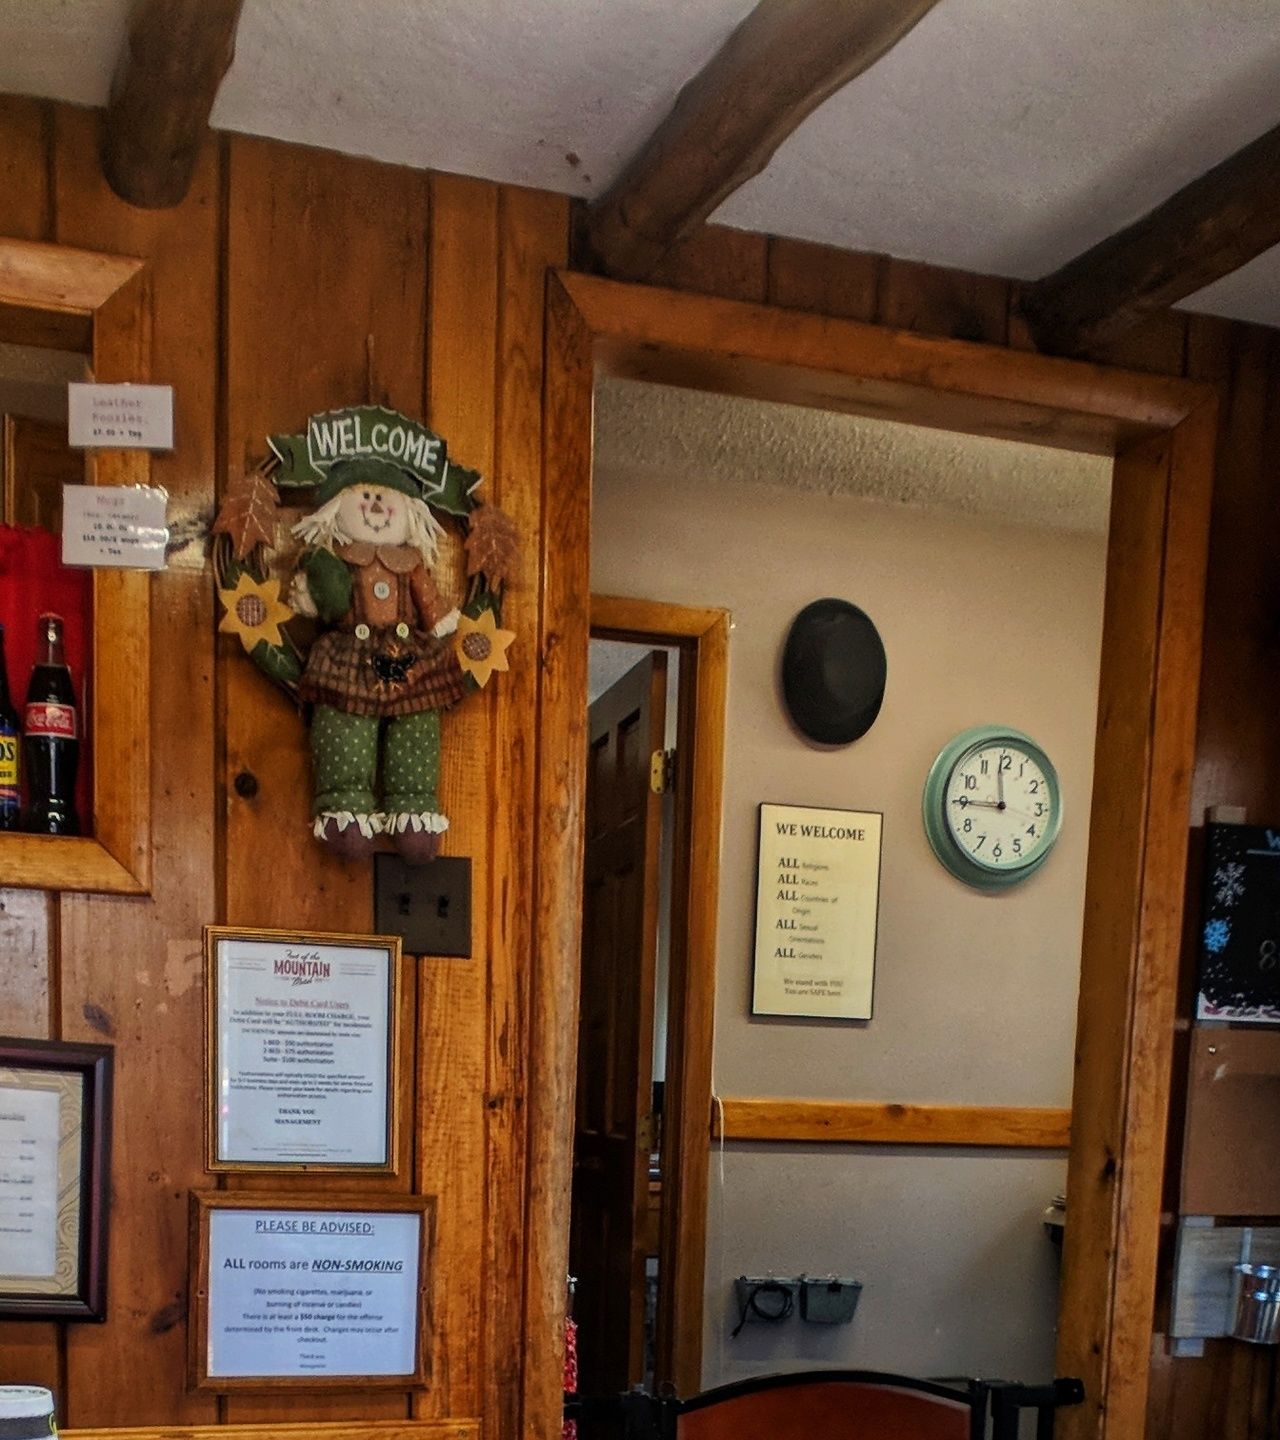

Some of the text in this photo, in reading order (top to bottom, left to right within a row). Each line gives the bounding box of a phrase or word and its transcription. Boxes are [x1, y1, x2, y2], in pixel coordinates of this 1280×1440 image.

[311, 415, 441, 474] WELCOME
[980, 759, 989, 775] 11
[1019, 762, 1024, 777] 1
[964, 774, 977, 790] 10
[1029, 780, 1039, 794] 2
[958, 795, 969, 810] 9
[1034, 802, 1044, 817] 3
[776, 822, 866, 842] WE WELCOME
[963, 818, 972, 833] 8
[1026, 823, 1036, 837] 4
[976, 835, 987, 850] 7
[992, 842, 1002, 857] 6
[1012, 838, 1022, 853] 5
[778, 857, 800, 869] ALL
[777, 873, 799, 885] ALL
[776, 889, 799, 901] ALL
[775, 918, 798, 930] ALL
[774, 947, 797, 959] ALL
[273, 958, 332, 979] MOUNTAIN
[255, 1219, 376, 1235] PLEASE BE ADVISED:
[223, 1257, 404, 1273] ALL rooms are NON-SMOKING
[267, 1287, 295, 1297] smoking
[300, 1313, 313, 1321] $50
[313, 1313, 336, 1322] charge
